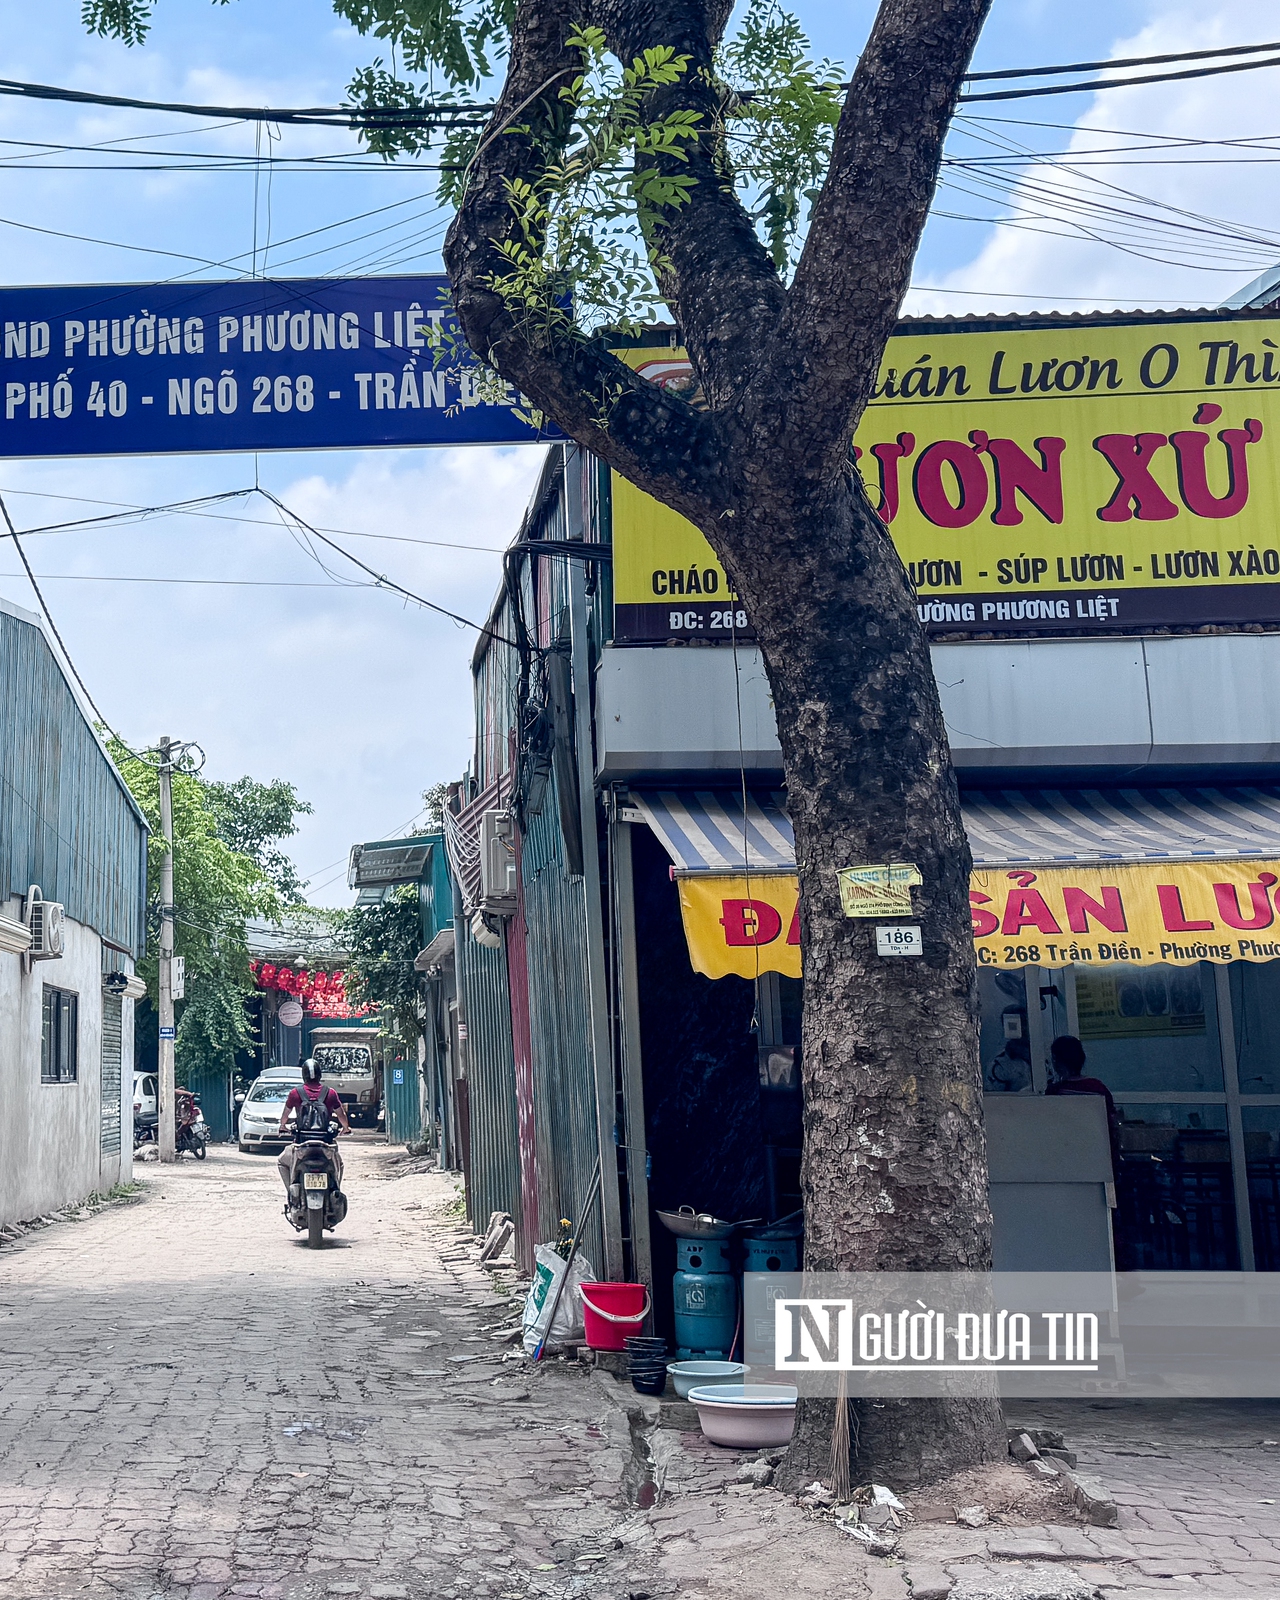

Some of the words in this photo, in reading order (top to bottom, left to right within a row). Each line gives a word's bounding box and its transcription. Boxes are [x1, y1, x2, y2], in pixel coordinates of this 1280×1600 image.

[64, 308, 205, 358] PHƯỜNG
[219, 308, 360, 353] PHƯƠNG
[374, 302, 447, 356] LIỆT
[6, 367, 75, 420] PHỐ
[86, 381, 128, 418] 40
[168, 369, 239, 416] NGÕ
[252, 375, 315, 414] 268
[354, 358, 446, 411] TRẦN
[868, 353, 971, 399] uán
[989, 351, 1123, 395] Lươn
[1139, 343, 1179, 389] O
[1199, 338, 1280, 386] Thì
[854, 429, 1067, 528] ƯƠN
[1092, 402, 1264, 523] XỨ
[652, 564, 719, 595] CHÁO
[909, 558, 963, 588] ƯƠN
[997, 553, 1048, 584] SÚP
[1057, 552, 1125, 583] LƯƠN
[1151, 549, 1220, 580] LƯƠN
[1228, 544, 1280, 577] XÀO
[669, 611, 704, 630] ĐC:
[710, 610, 748, 629] 268
[917, 599, 976, 623] ƯỜNG
[982, 598, 1070, 621] PHƯƠNG
[1077, 595, 1120, 622] LIỆT
[1156, 871, 1280, 933] LƯ
[884, 932, 914, 944] 186
[978, 946, 998, 965] C:
[1004, 945, 1042, 964] 268
[1046, 941, 1093, 962] Trần
[1098, 941, 1142, 961] Điền
[1160, 940, 1233, 961] Phường
[395, 1069, 402, 1079] 8
